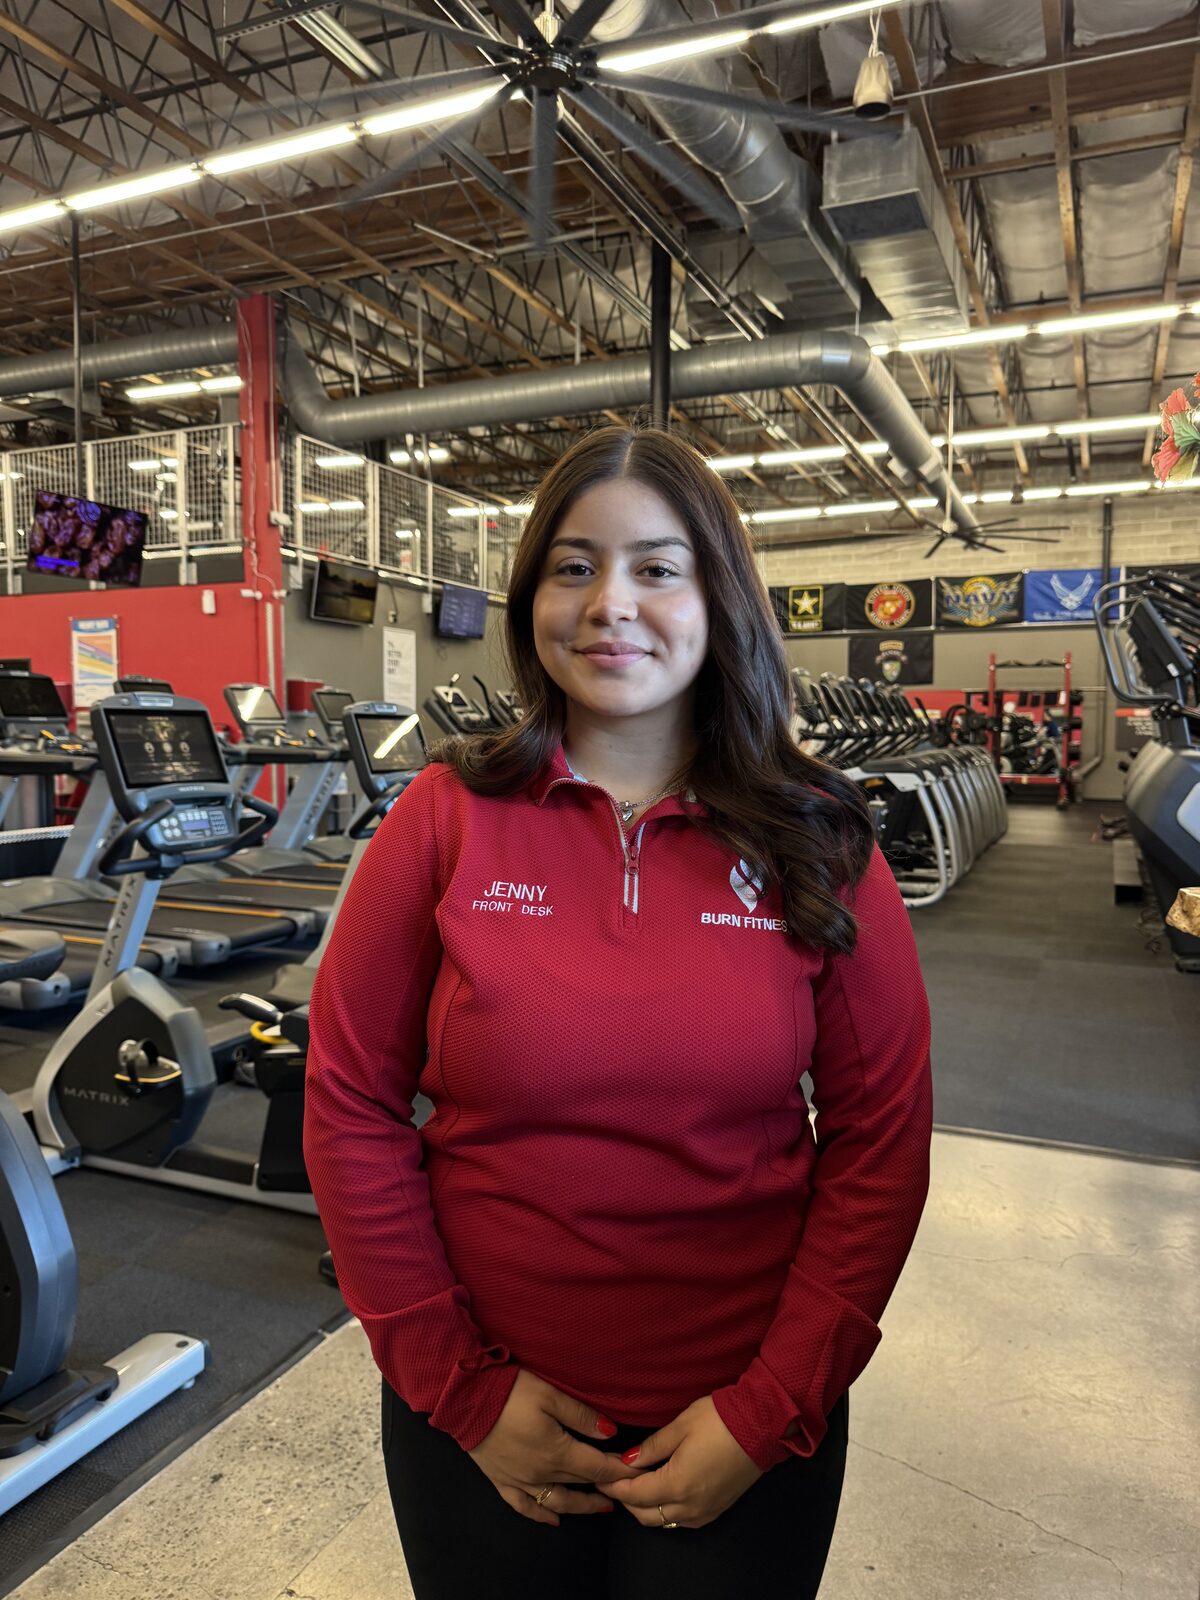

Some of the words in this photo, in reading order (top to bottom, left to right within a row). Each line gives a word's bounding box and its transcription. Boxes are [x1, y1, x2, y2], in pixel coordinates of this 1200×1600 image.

[944, 589, 1017, 607] NAVY
[483, 880, 548, 902] JENNY
[472, 899, 514, 913] FRONT
[521, 903, 554, 917] DESK
[104, 877, 135, 967] MATRIX
[700, 912, 742, 928] BURN
[744, 915, 789, 932] FITNES
[63, 1086, 131, 1107] MATRIX
